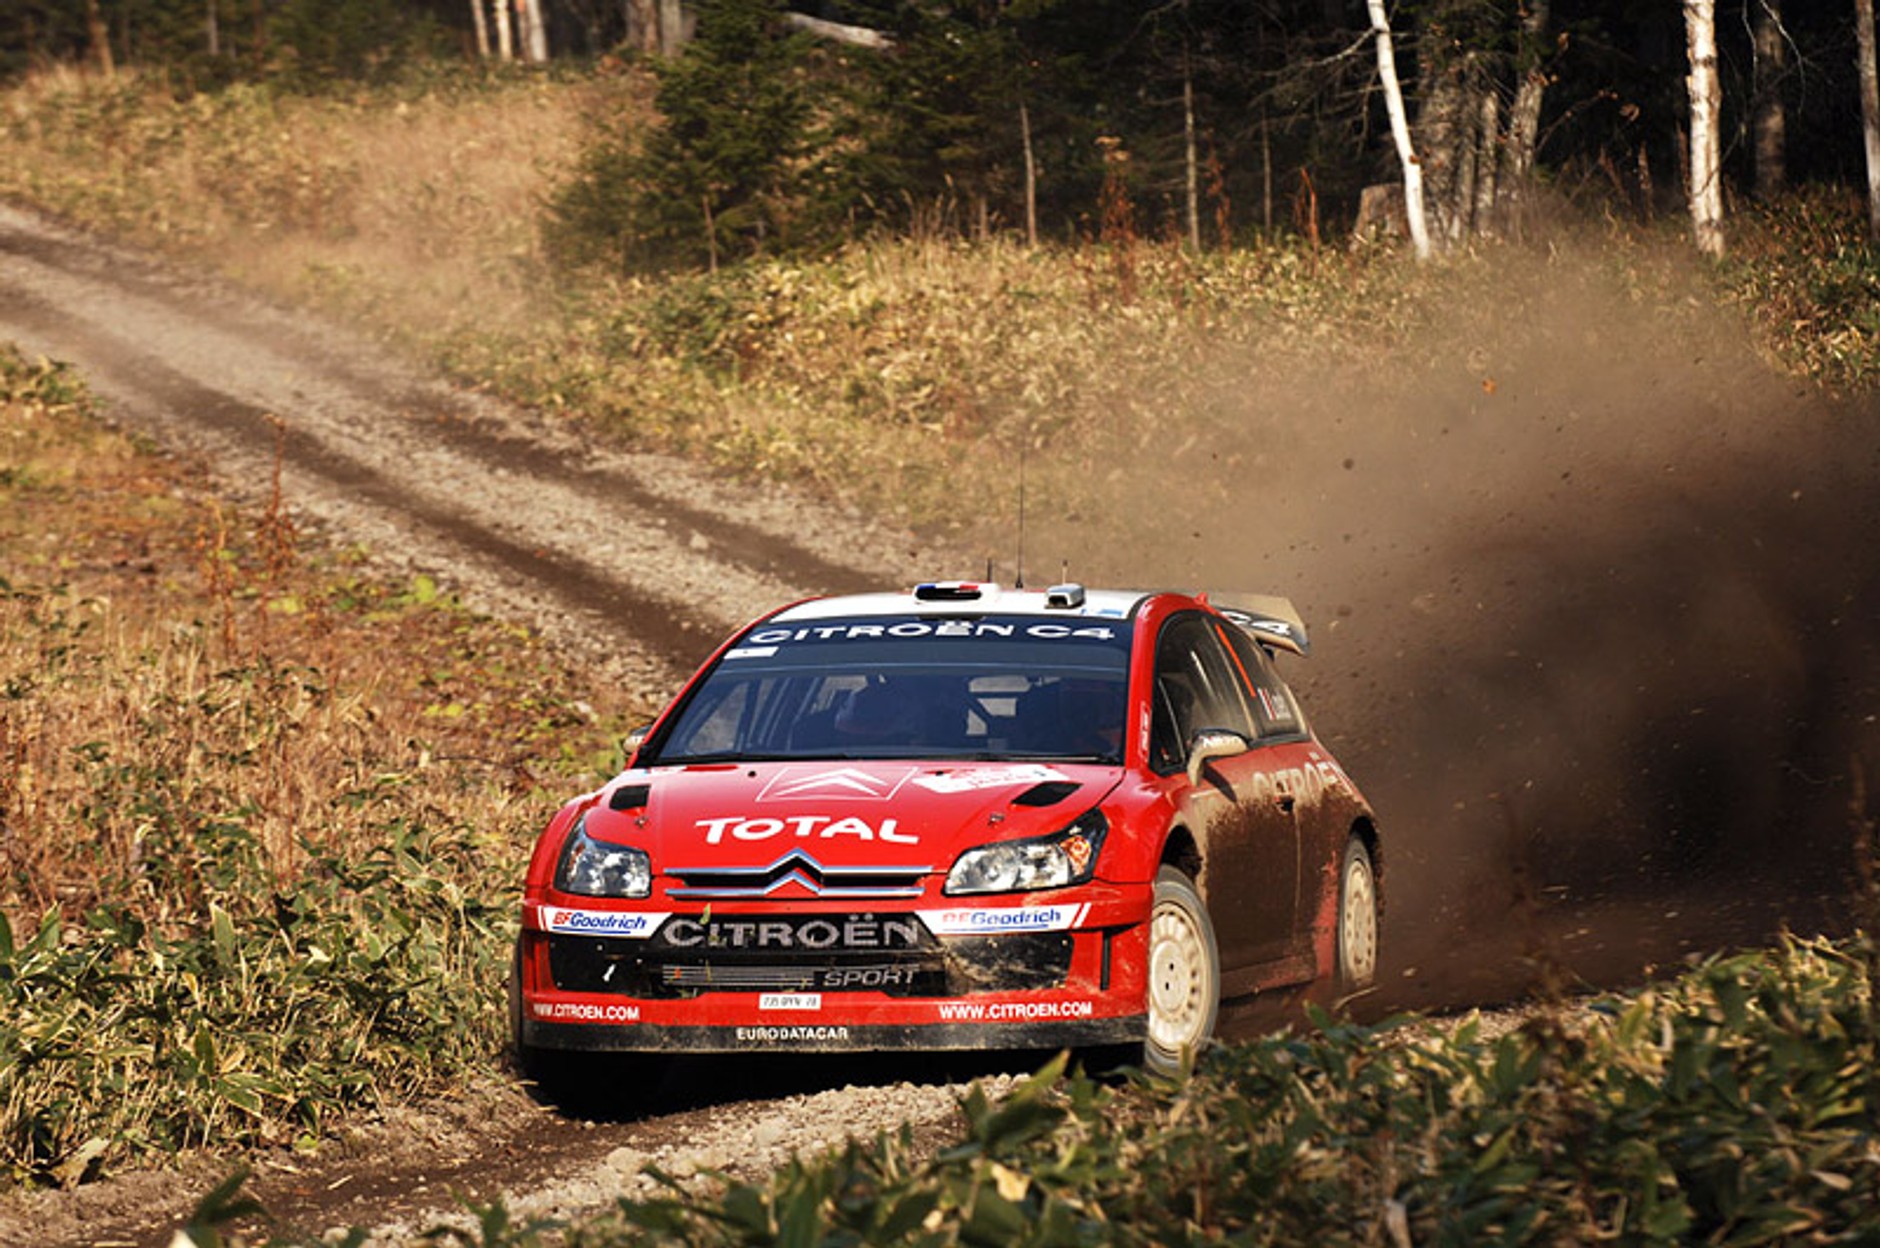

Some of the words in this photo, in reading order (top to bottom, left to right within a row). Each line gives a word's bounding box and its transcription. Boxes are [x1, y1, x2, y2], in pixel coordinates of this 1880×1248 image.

[749, 620, 1014, 644] CITROËN
[1027, 626, 1116, 641] C4
[695, 816, 919, 844] TOTAL
[553, 911, 647, 930] BFGoodrich
[663, 914, 919, 948] CITROËN
[822, 968, 918, 987] SPORT
[533, 1003, 640, 1020] WWW.CITROEN.COM
[938, 1001, 1093, 1019] WWW.CITROEN.COM
[736, 1026, 848, 1040] EURODATACAR
